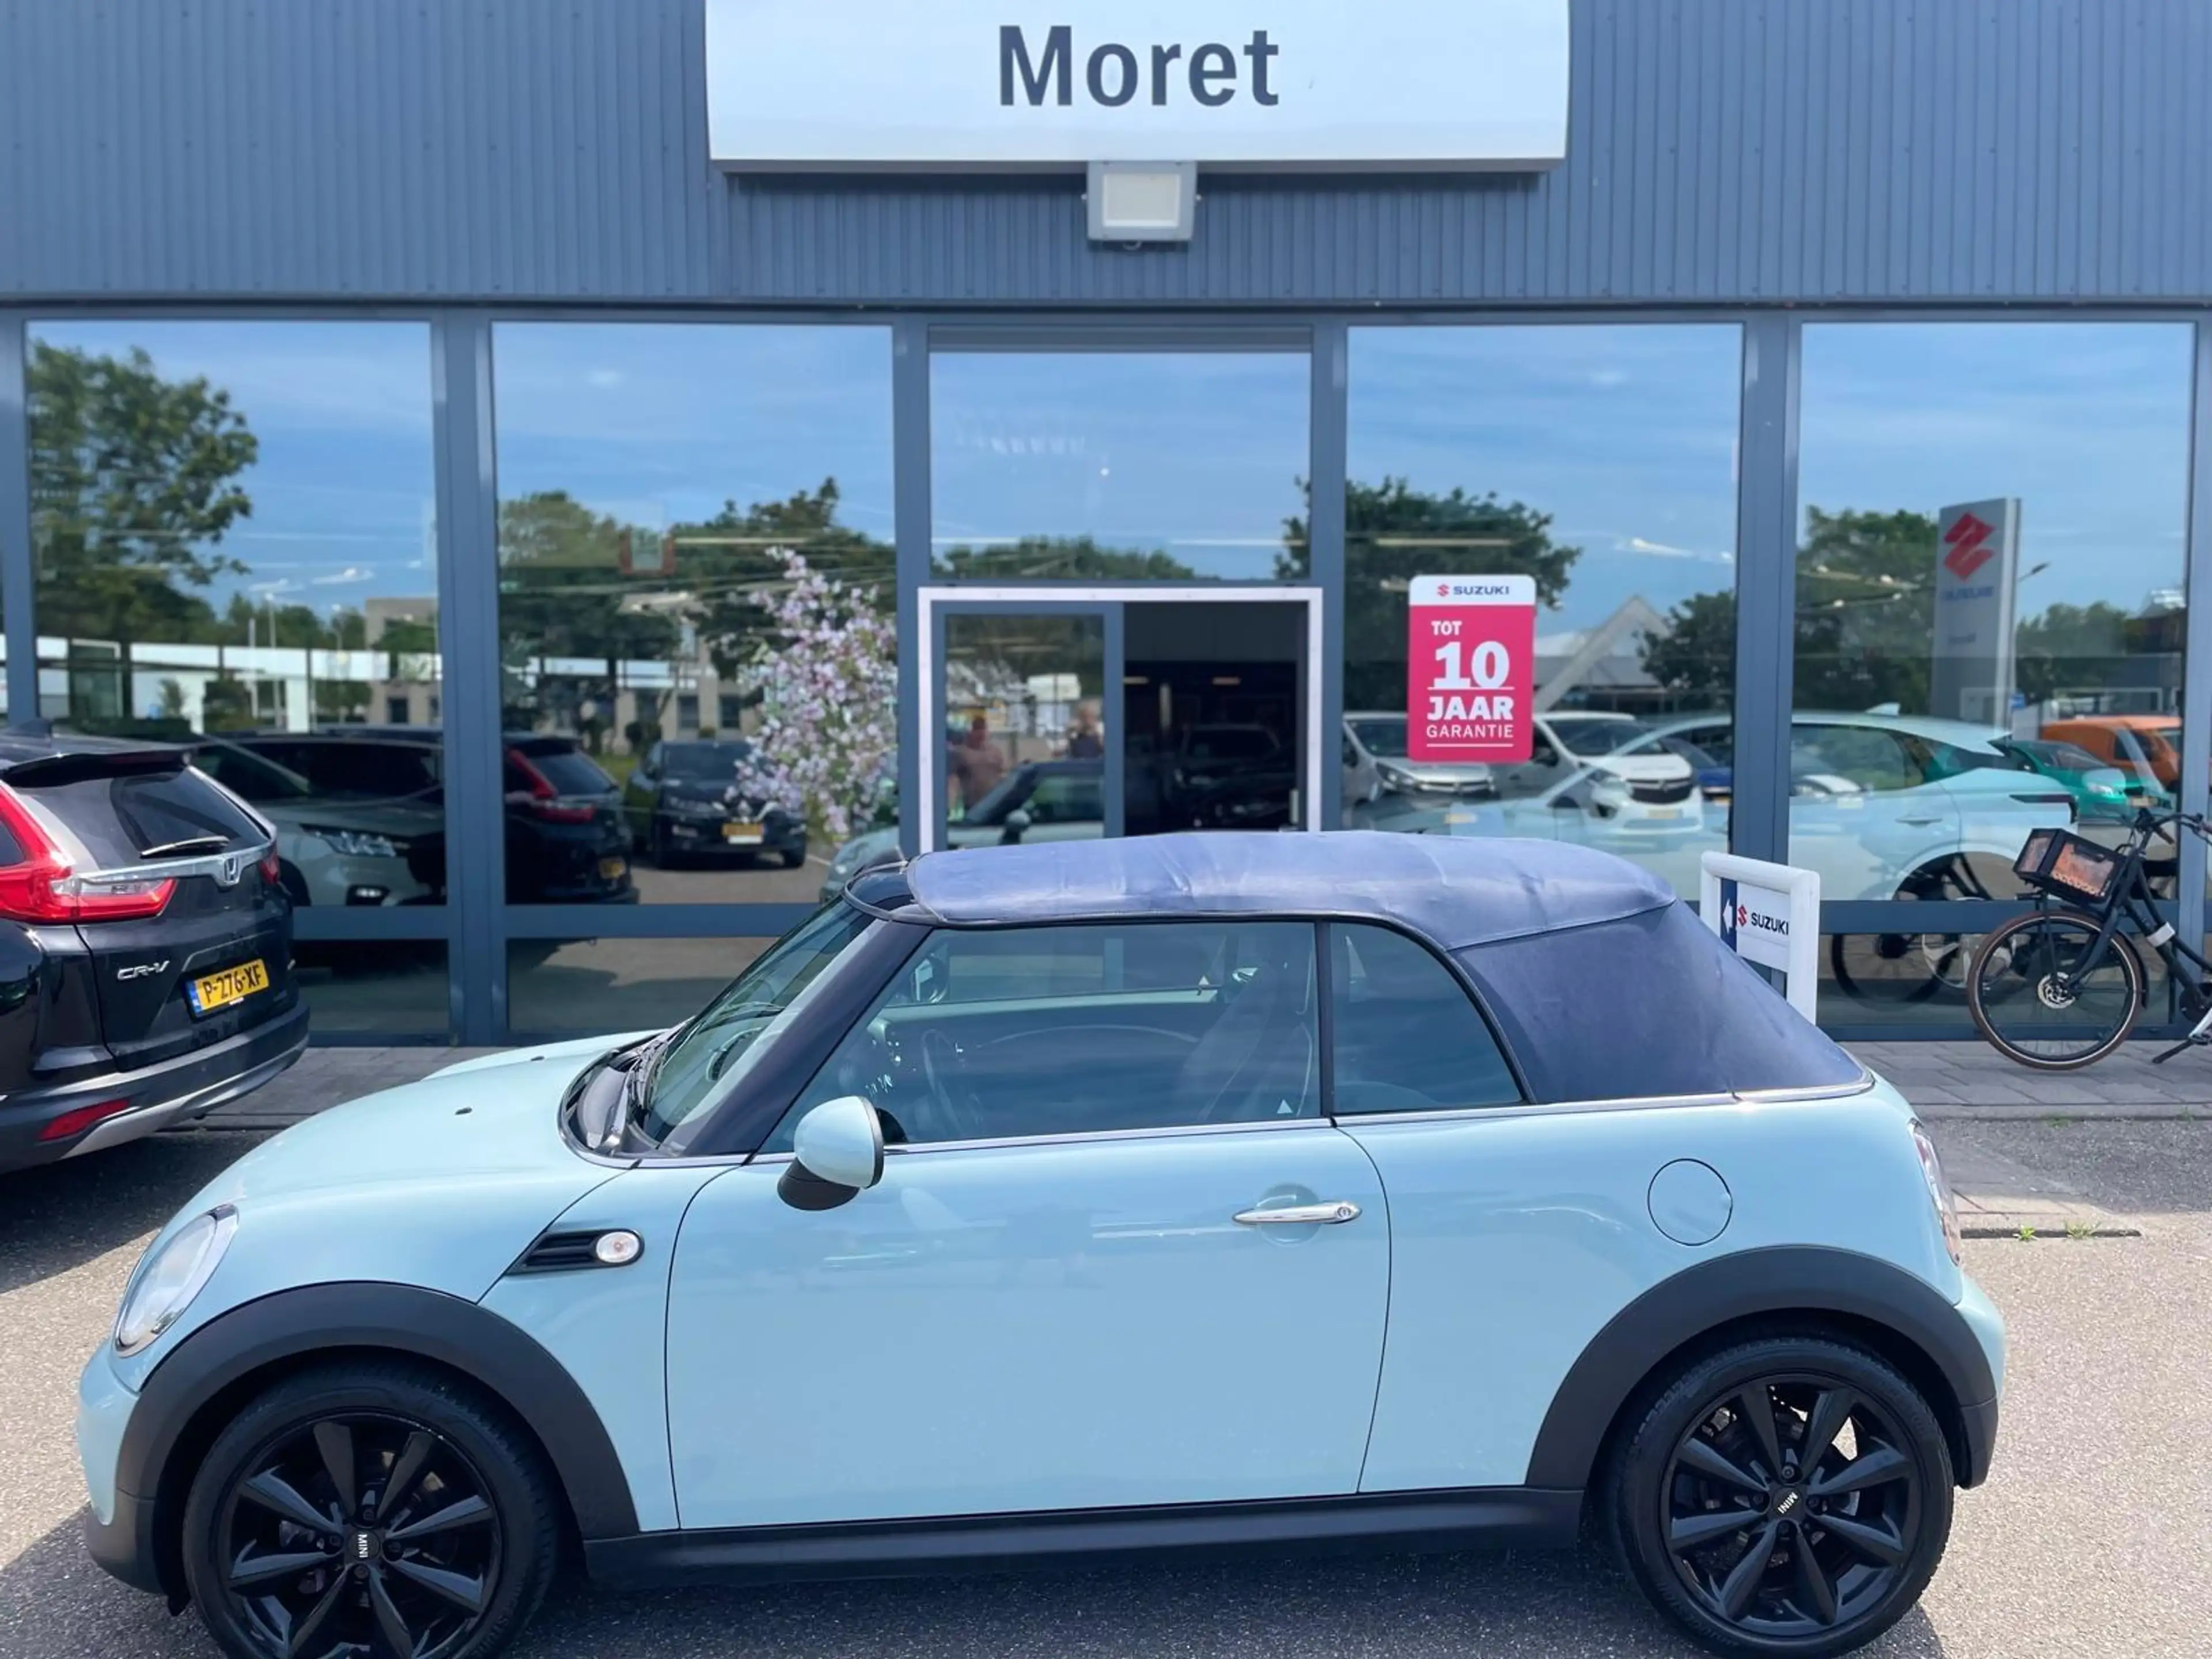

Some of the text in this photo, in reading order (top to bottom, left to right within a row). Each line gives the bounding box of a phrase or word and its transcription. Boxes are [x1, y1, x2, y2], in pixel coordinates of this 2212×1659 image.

[999, 25, 1279, 107] Moret
[1453, 586, 1509, 595] SUZUKI
[1431, 620, 1462, 635] TOT
[1434, 641, 1509, 689] 10
[1427, 696, 1514, 721] JAAR
[1426, 725, 1514, 738] GARANTIE
[1751, 912, 1789, 935] SUZUKI
[117, 960, 169, 980] CR-V
[202, 964, 261, 1003] P-276-XF
[1778, 1491, 1798, 1514] MINI
[358, 1533, 368, 1558] MINI
